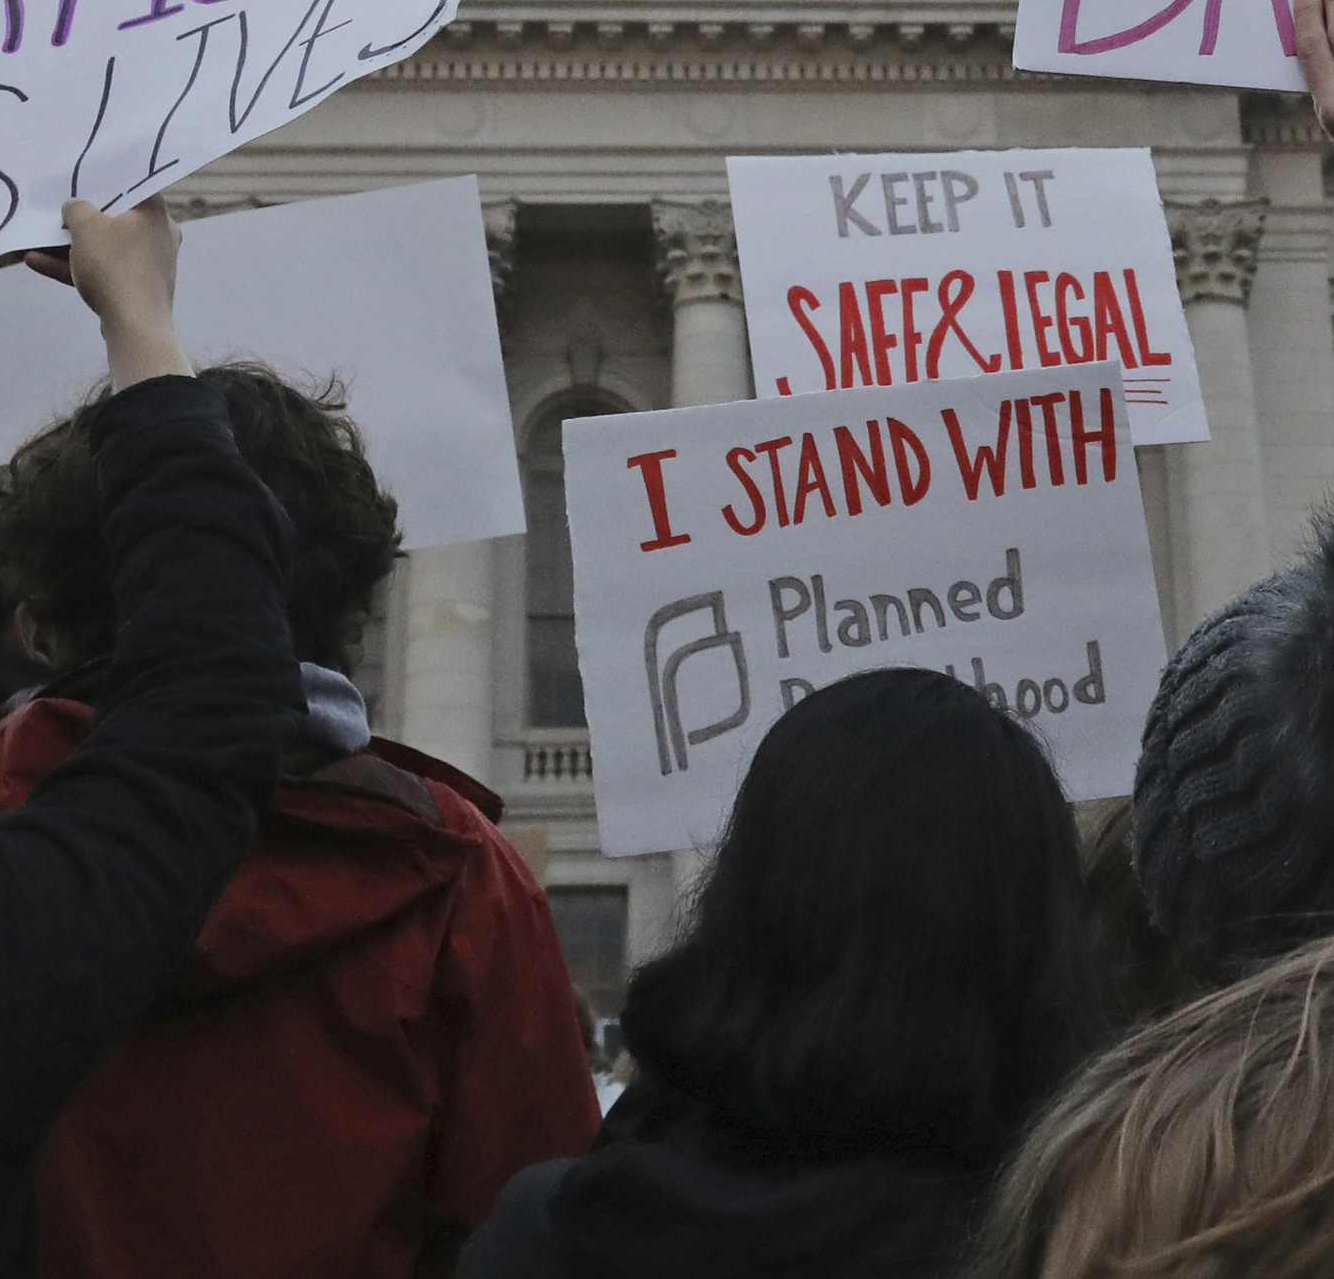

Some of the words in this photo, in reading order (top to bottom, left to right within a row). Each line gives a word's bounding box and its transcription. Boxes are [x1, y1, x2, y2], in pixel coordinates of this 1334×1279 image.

[828, 171, 980, 239] KEEP
[1007, 169, 1055, 229] IT
[627, 449, 691, 552] I
[721, 417, 932, 537] STAND
[941, 387, 1118, 502] WITH
[768, 548, 1025, 659] Planned
